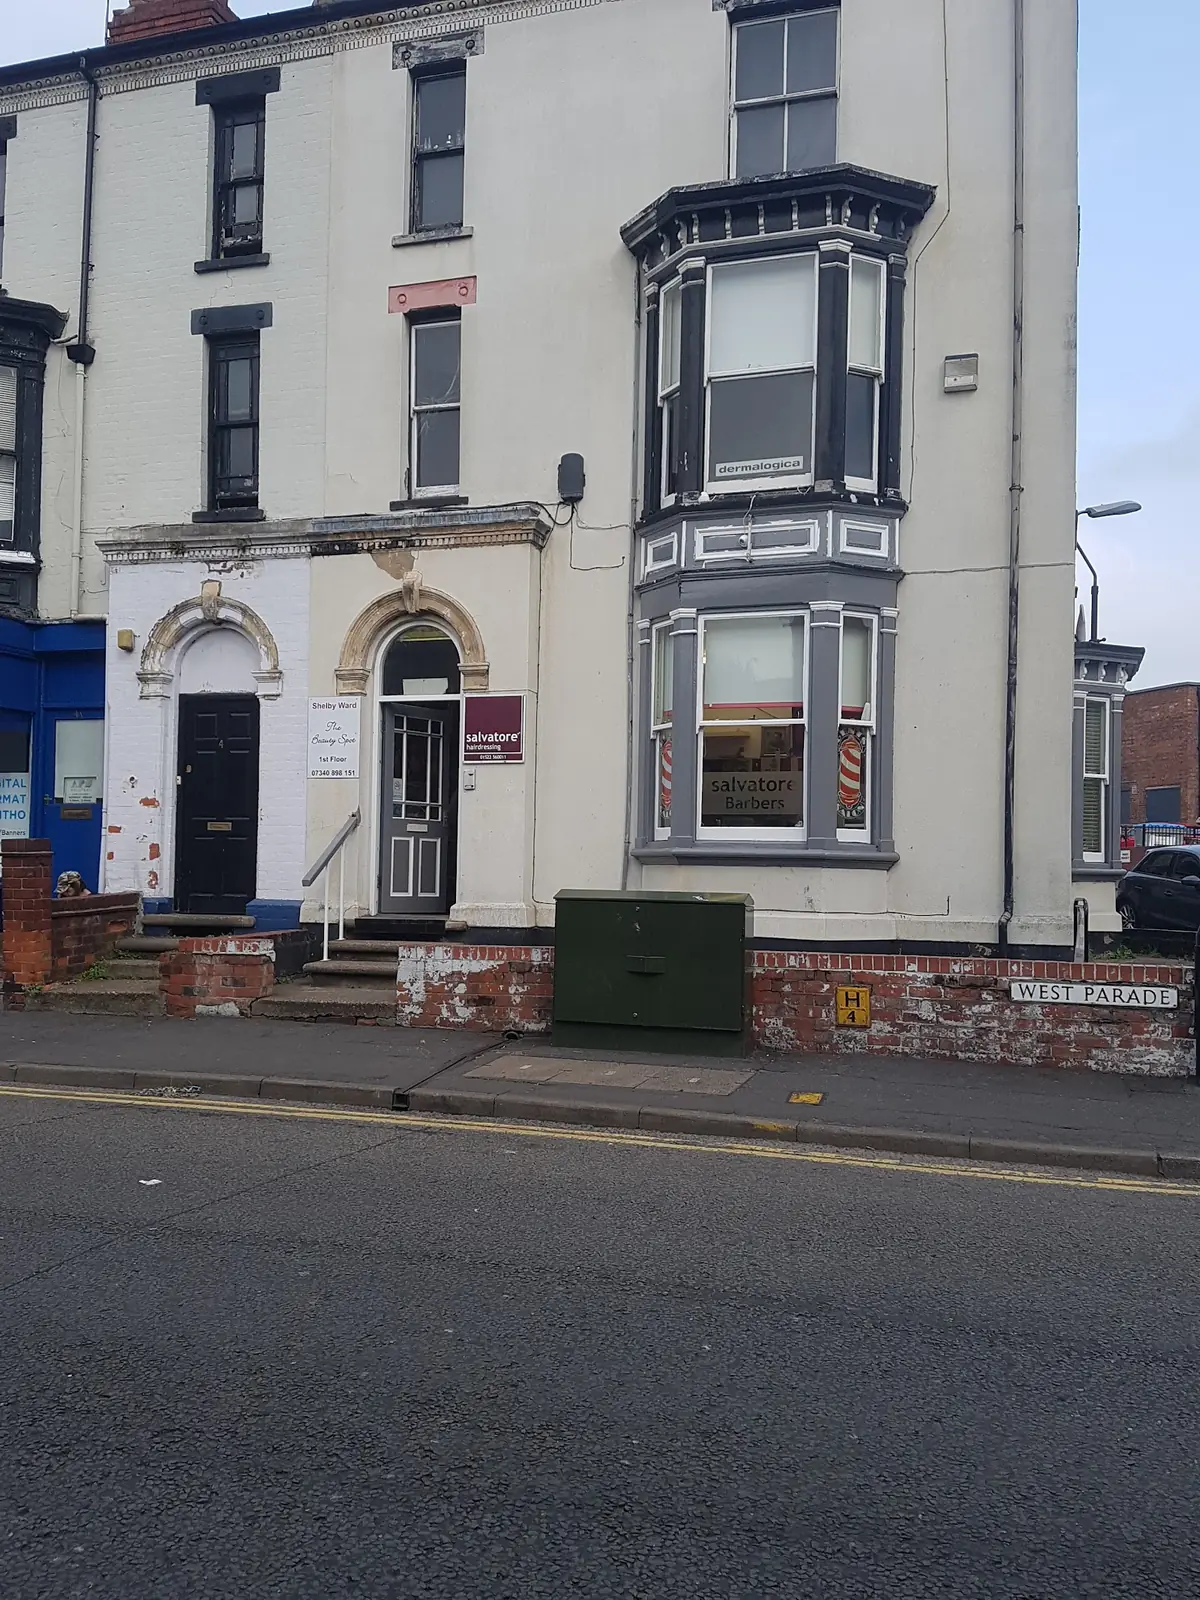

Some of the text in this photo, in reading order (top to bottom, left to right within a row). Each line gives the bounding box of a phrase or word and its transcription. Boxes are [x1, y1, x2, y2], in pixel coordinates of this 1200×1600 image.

[719, 460, 801, 474] dermalogica
[312, 702, 337, 711] Shelby
[325, 721, 341, 732] The
[311, 733, 356, 747] Beauty Spot
[466, 731, 519, 743] salvatore
[466, 743, 502, 751] hairdressing
[311, 769, 330, 777] 07340
[344, 769, 356, 777] 151
[0, 778, 27, 788] ITAL
[711, 776, 793, 793] salvatore
[0, 794, 27, 804] MAT
[725, 796, 785, 810] Barbers
[845, 991, 860, 1008] H
[1018, 983, 1171, 1005] WEST PARADE
[846, 1010, 856, 1023] 4
